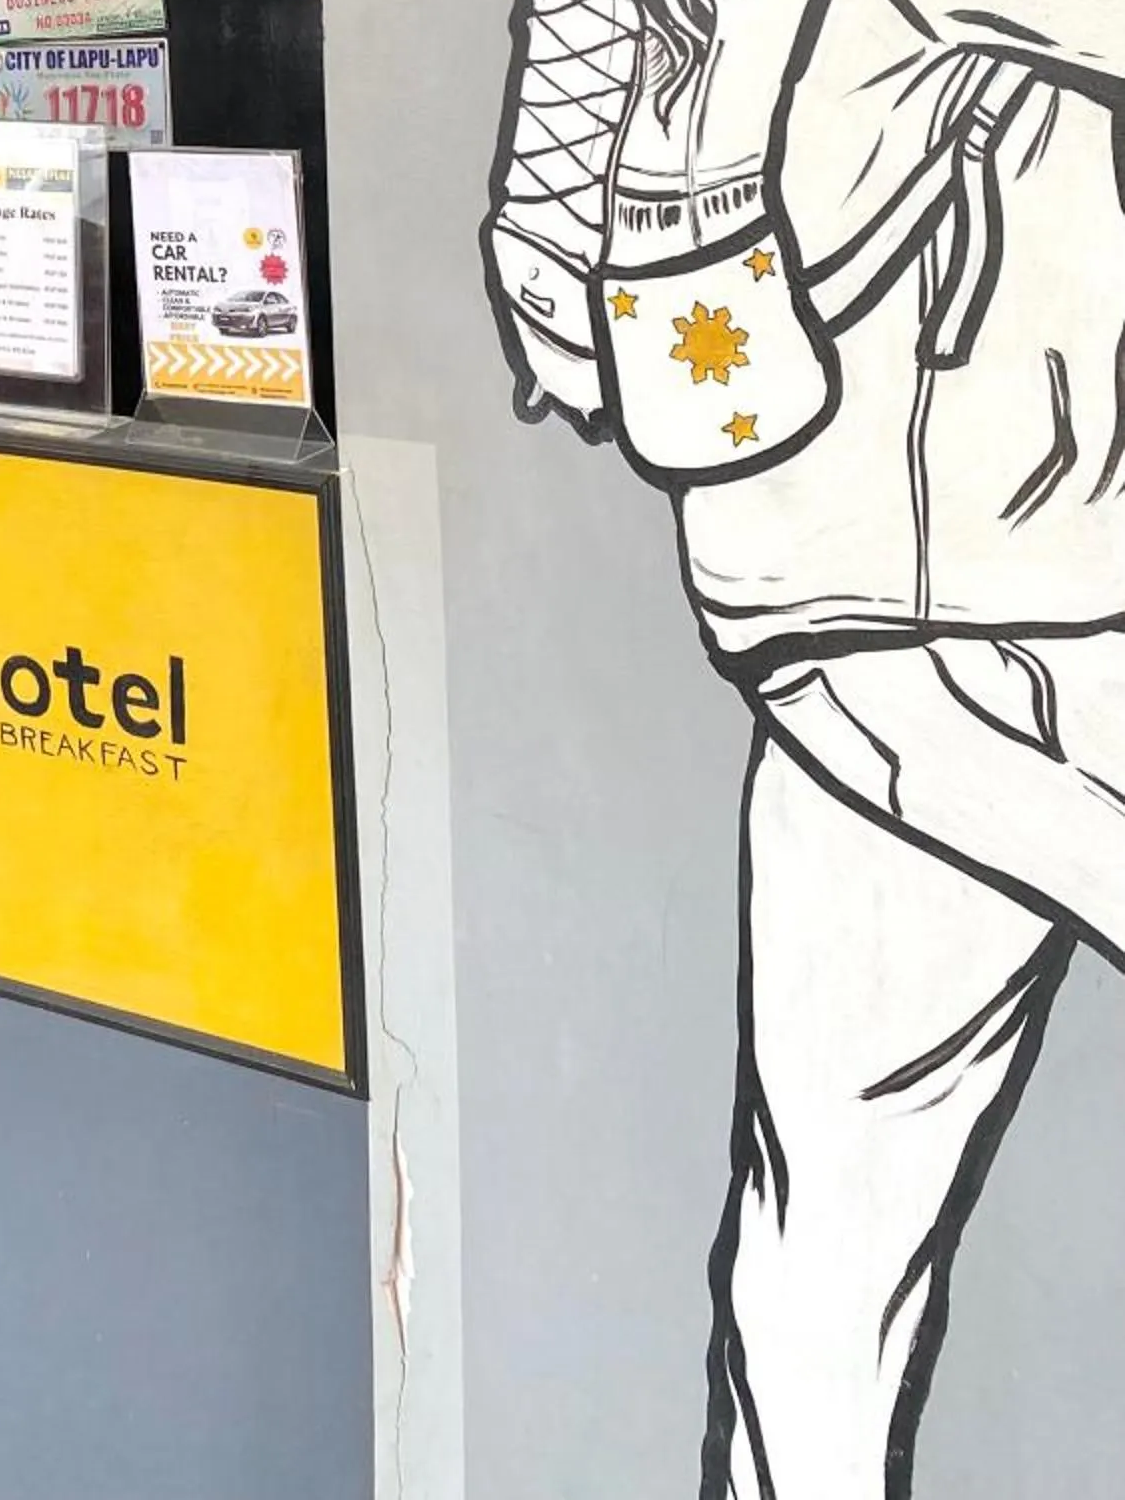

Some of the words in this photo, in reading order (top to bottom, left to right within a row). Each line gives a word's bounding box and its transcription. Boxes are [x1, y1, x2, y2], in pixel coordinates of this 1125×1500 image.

[5, 49, 42, 72] CITY
[46, 49, 66, 69] OF
[69, 47, 159, 69] LAPU-LAPU
[45, 83, 147, 129] 11718
[20, 206, 56, 220] Rates
[150, 231, 184, 242] NEED
[188, 232, 198, 243] A
[152, 244, 187, 261] CAR
[153, 265, 228, 283] RENTAL?
[0, 722, 188, 781] BREAKFAST
